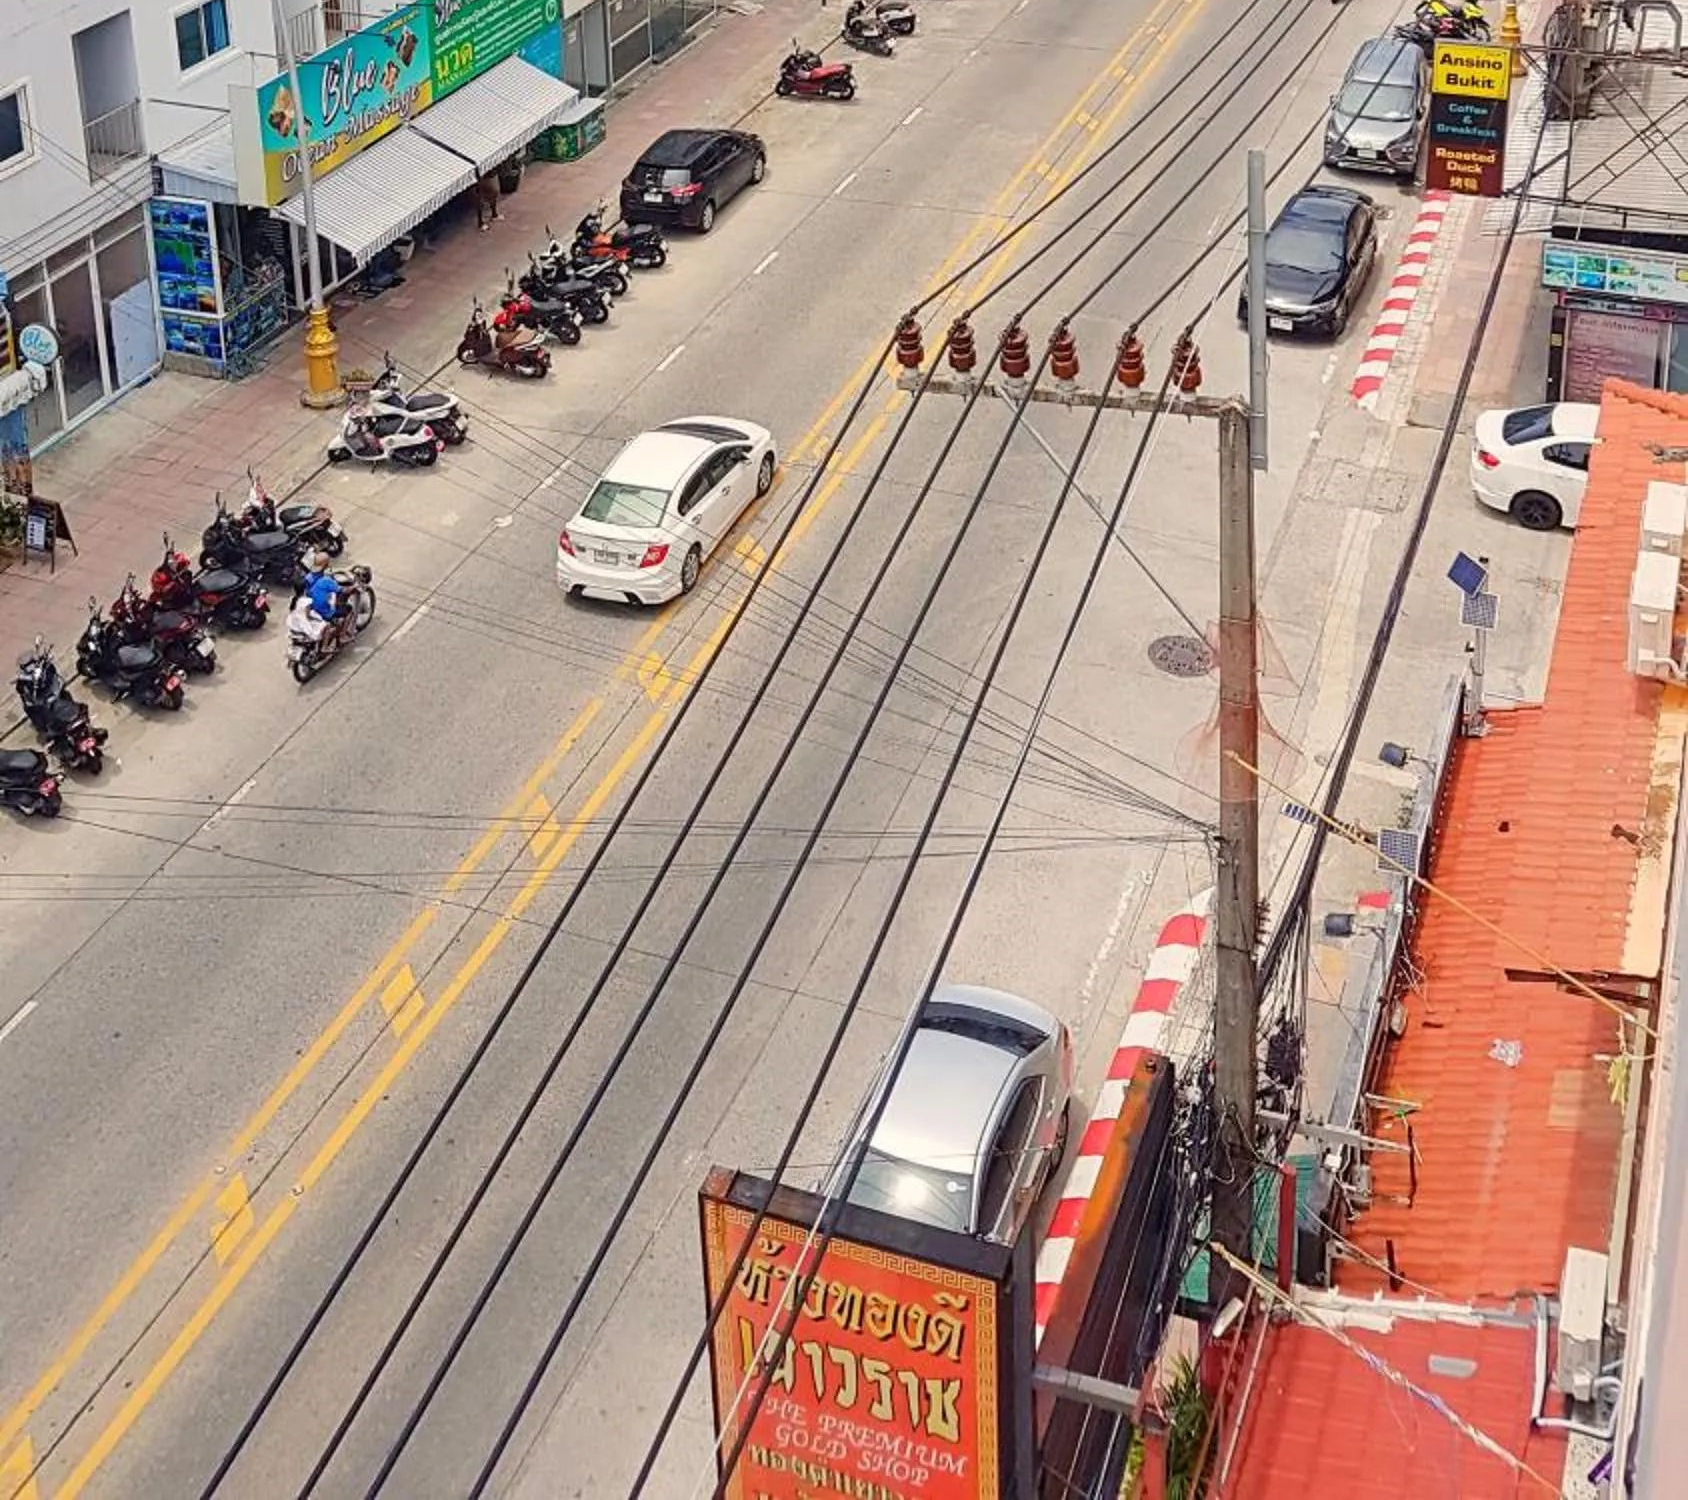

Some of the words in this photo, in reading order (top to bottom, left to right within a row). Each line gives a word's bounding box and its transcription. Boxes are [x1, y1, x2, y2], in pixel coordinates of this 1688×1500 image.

[436, 42, 473, 79] นวด
[1439, 53, 1503, 71] Ansino
[321, 47, 377, 125] Blue
[1445, 73, 1495, 89] Bukit
[1436, 124, 1496, 137] Breakfast
[1435, 148, 1496, 164] Roasted
[1446, 162, 1482, 174] Duck
[817, 1413, 968, 1477] PREMIUM
[775, 1423, 847, 1460] GOLD
[857, 1451, 929, 1486] SHOP
